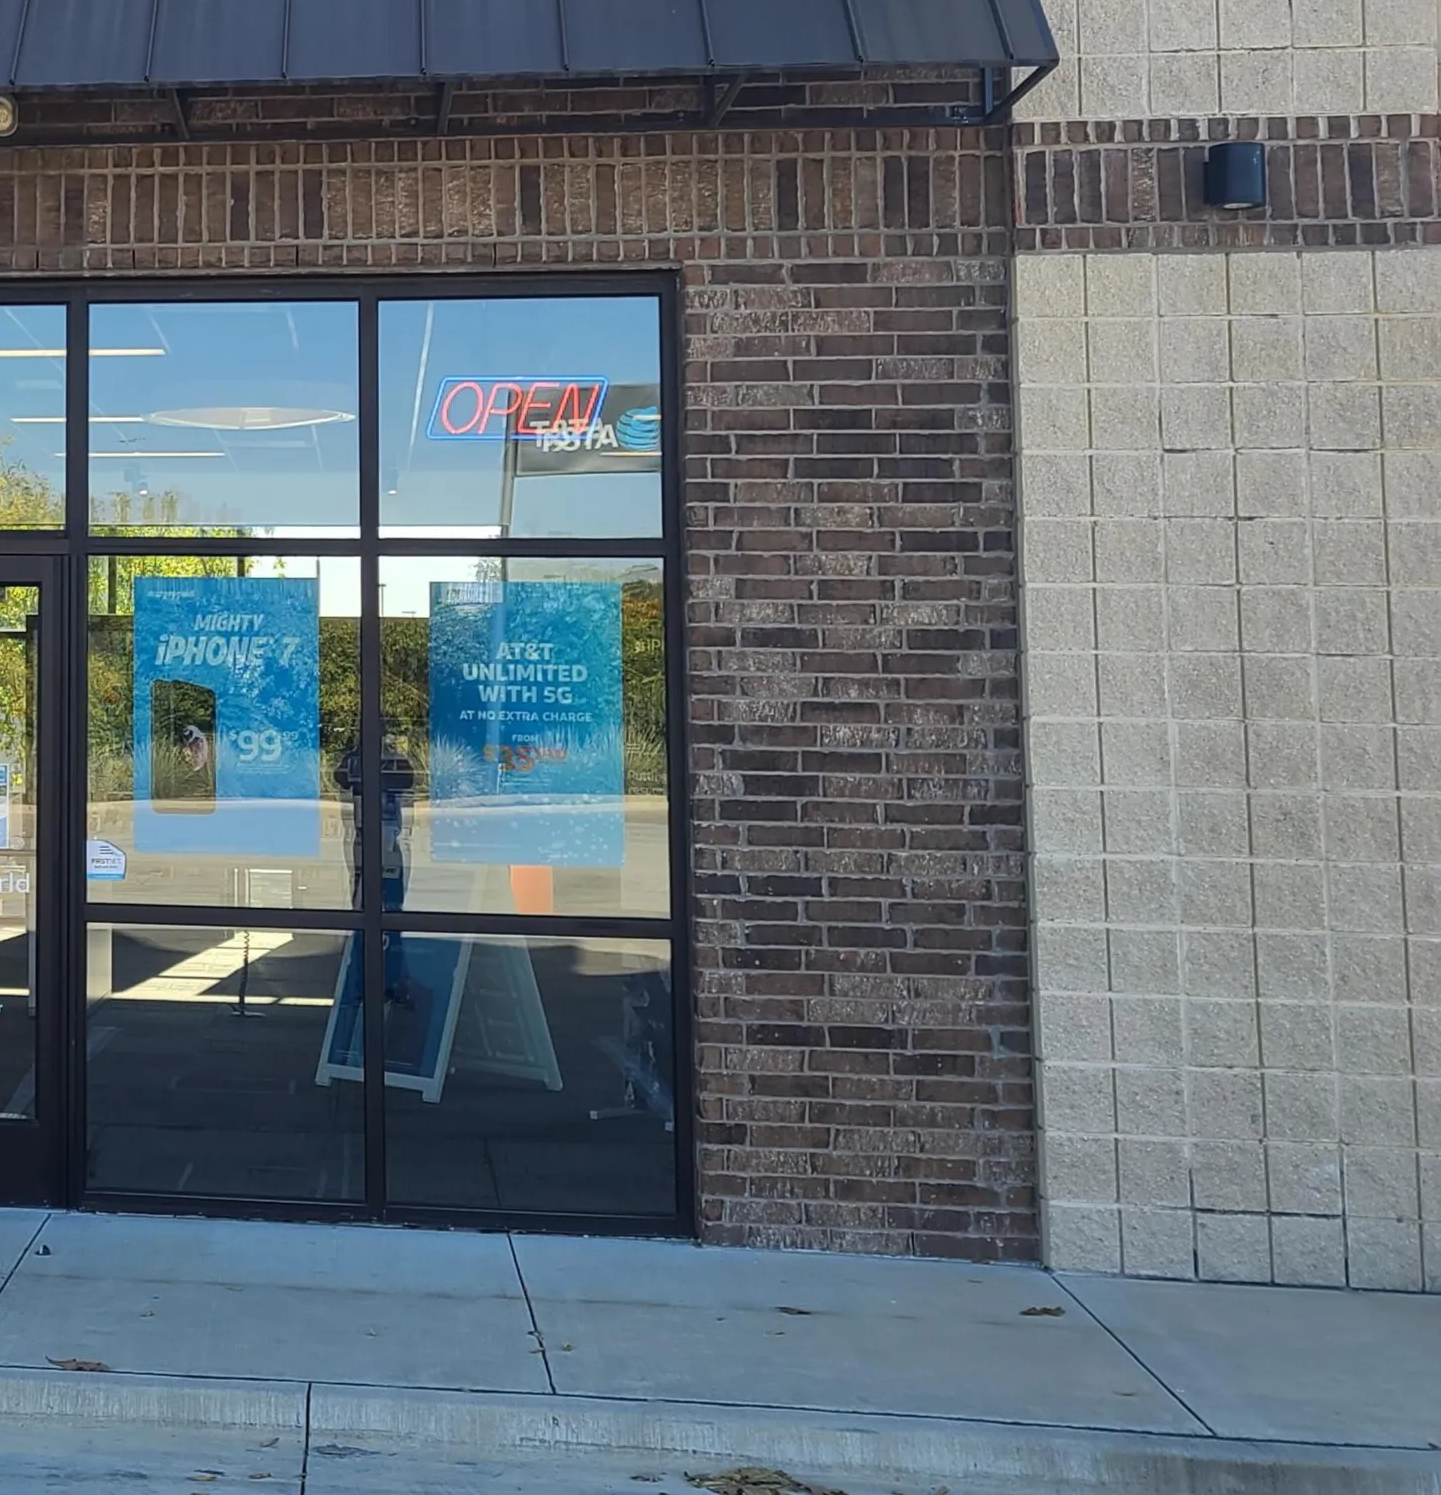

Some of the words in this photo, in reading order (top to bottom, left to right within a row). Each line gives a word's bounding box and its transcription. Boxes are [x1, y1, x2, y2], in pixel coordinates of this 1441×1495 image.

[441, 381, 600, 435] OPEN
[194, 613, 265, 632] MIGHTY
[279, 636, 301, 667] 7
[496, 642, 555, 660] AT&T
[462, 663, 588, 682] UNLIMITED
[478, 685, 538, 703] WITH
[544, 687, 573, 704] 5G
[459, 710, 473, 720] AT
[477, 710, 495, 720] NO
[498, 710, 540, 721] EXTRA
[542, 712, 593, 722] CHARGE
